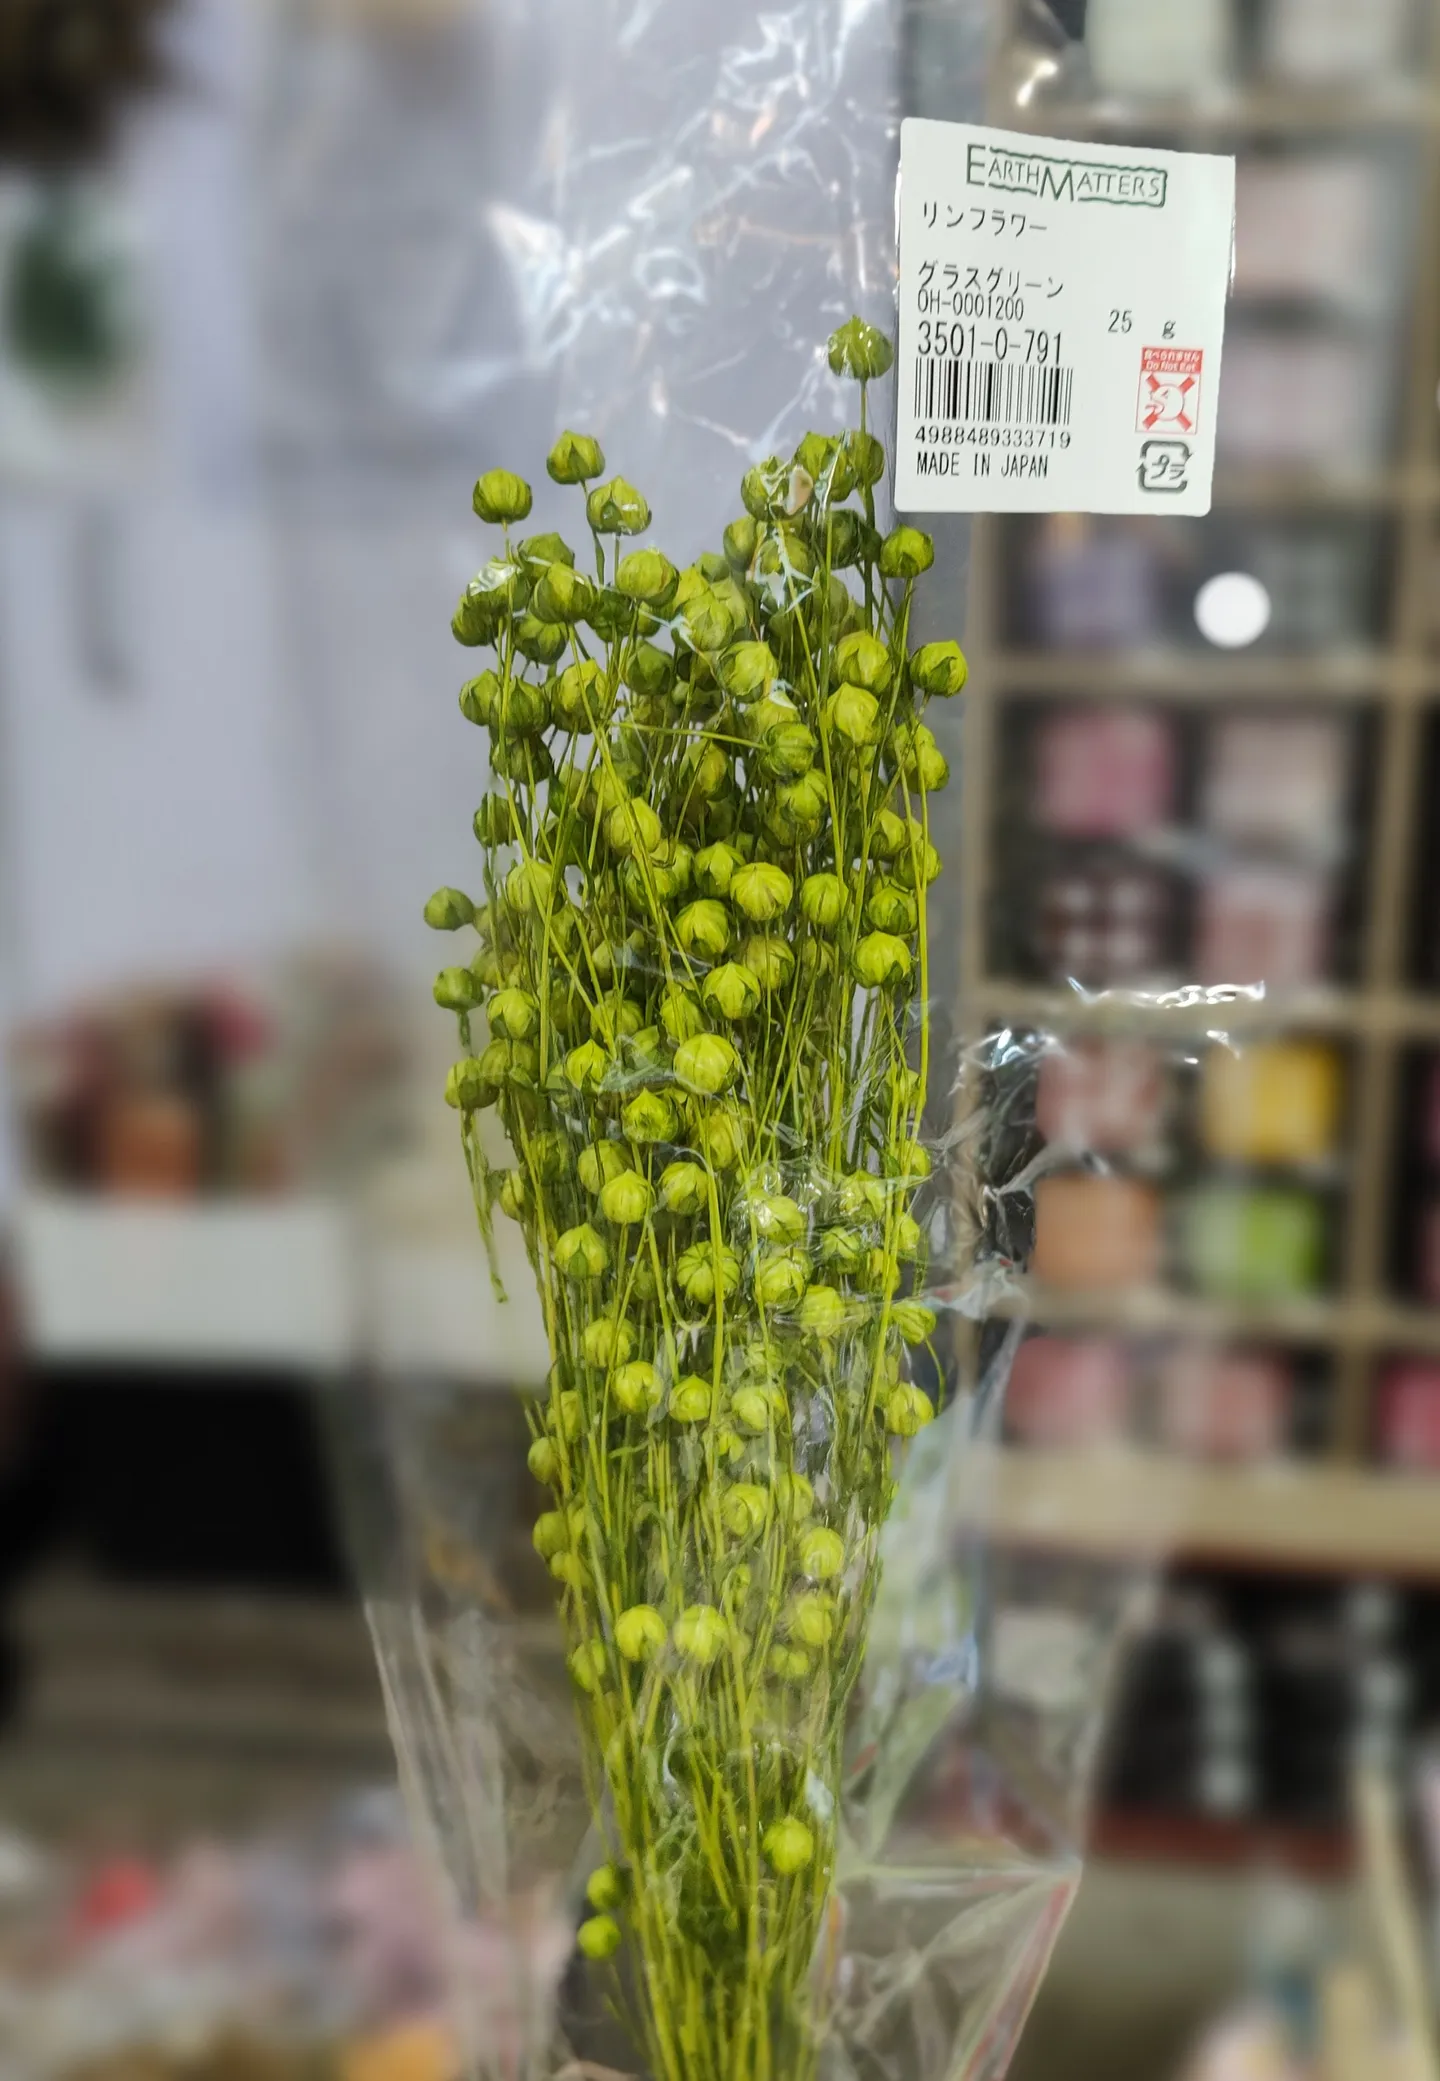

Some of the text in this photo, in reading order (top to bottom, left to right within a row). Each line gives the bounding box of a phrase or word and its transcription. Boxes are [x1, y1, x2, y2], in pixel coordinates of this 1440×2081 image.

[923, 202, 1047, 237] リンフラワー
[918, 260, 1063, 298] グラスグリーン
[1108, 309, 1176, 339] 25 g
[917, 319, 1061, 365] 3501-0-791
[915, 425, 1071, 449] 4988489333719
[916, 451, 1048, 478] MADE IN JAPAN
